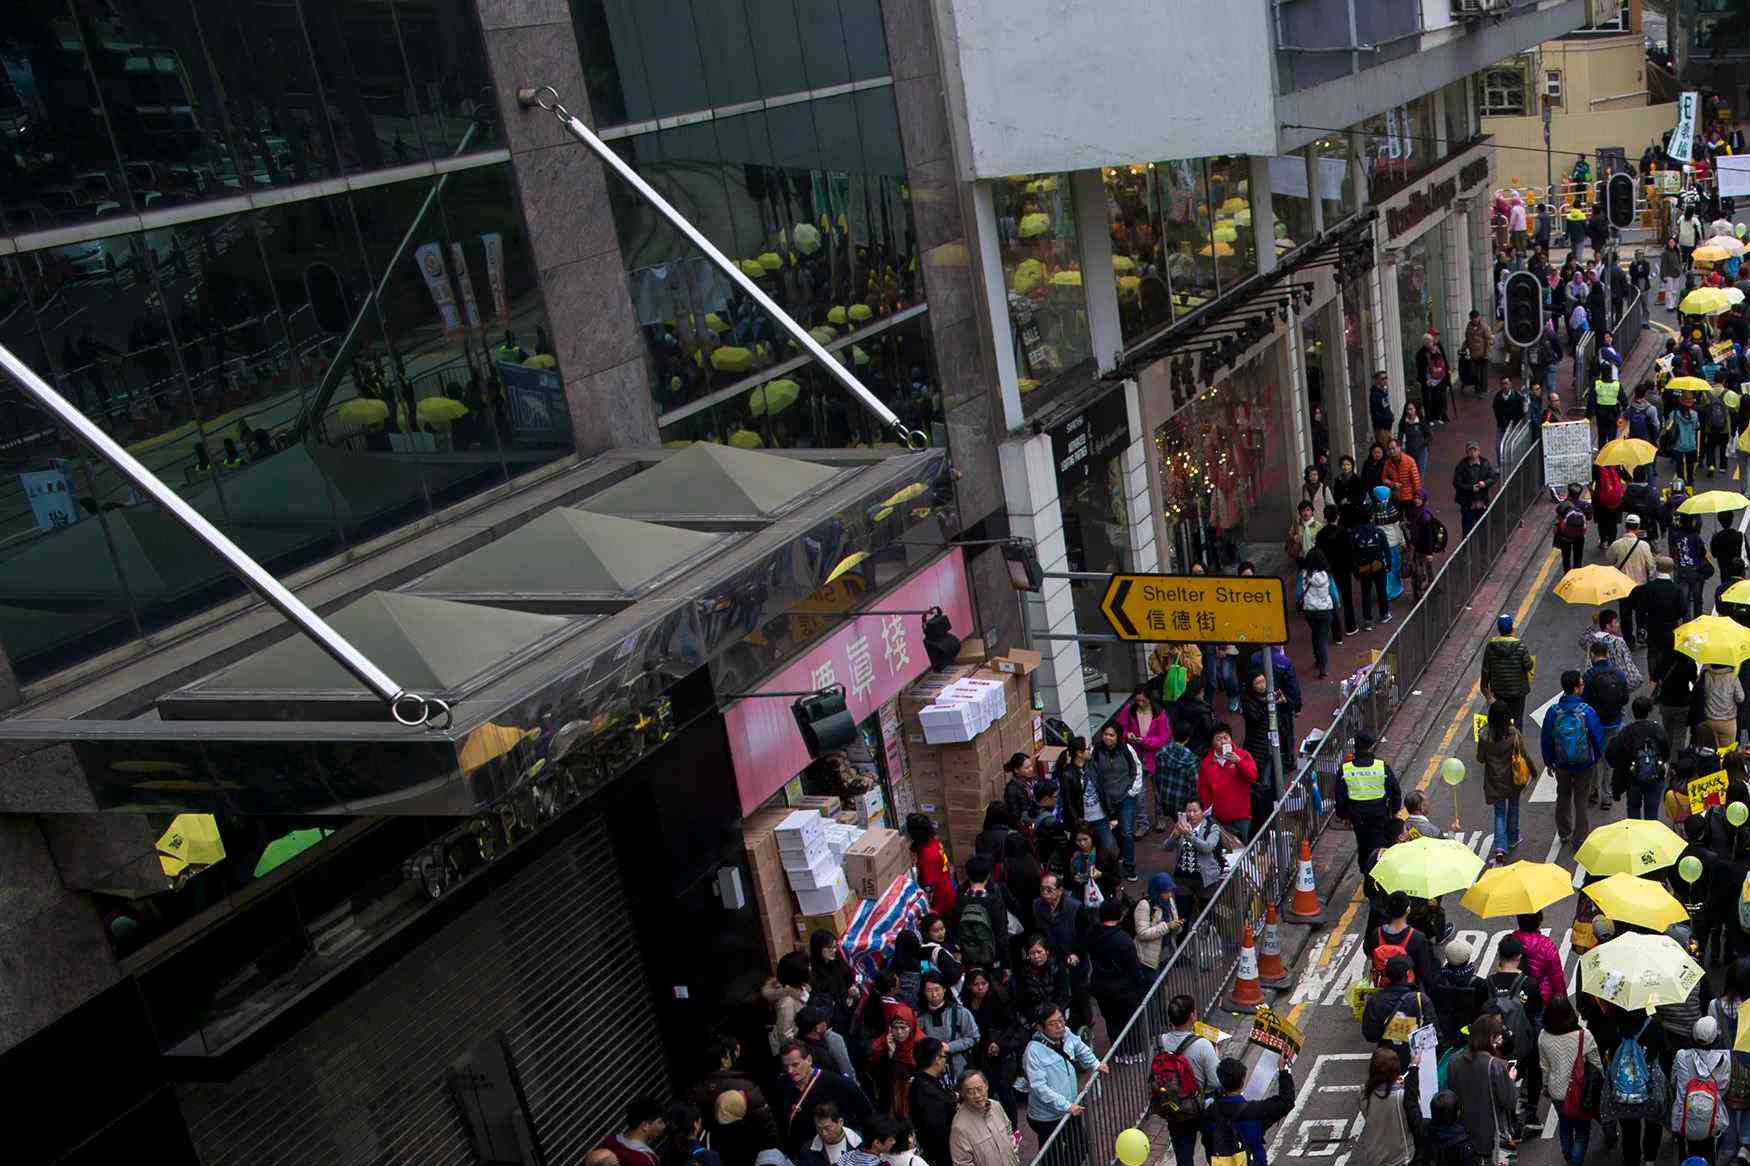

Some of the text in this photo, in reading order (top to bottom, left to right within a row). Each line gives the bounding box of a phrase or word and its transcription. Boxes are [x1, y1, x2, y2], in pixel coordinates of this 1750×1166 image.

[1143, 585, 1273, 605] Shelter Street
[1144, 608, 1217, 633] 信德街
